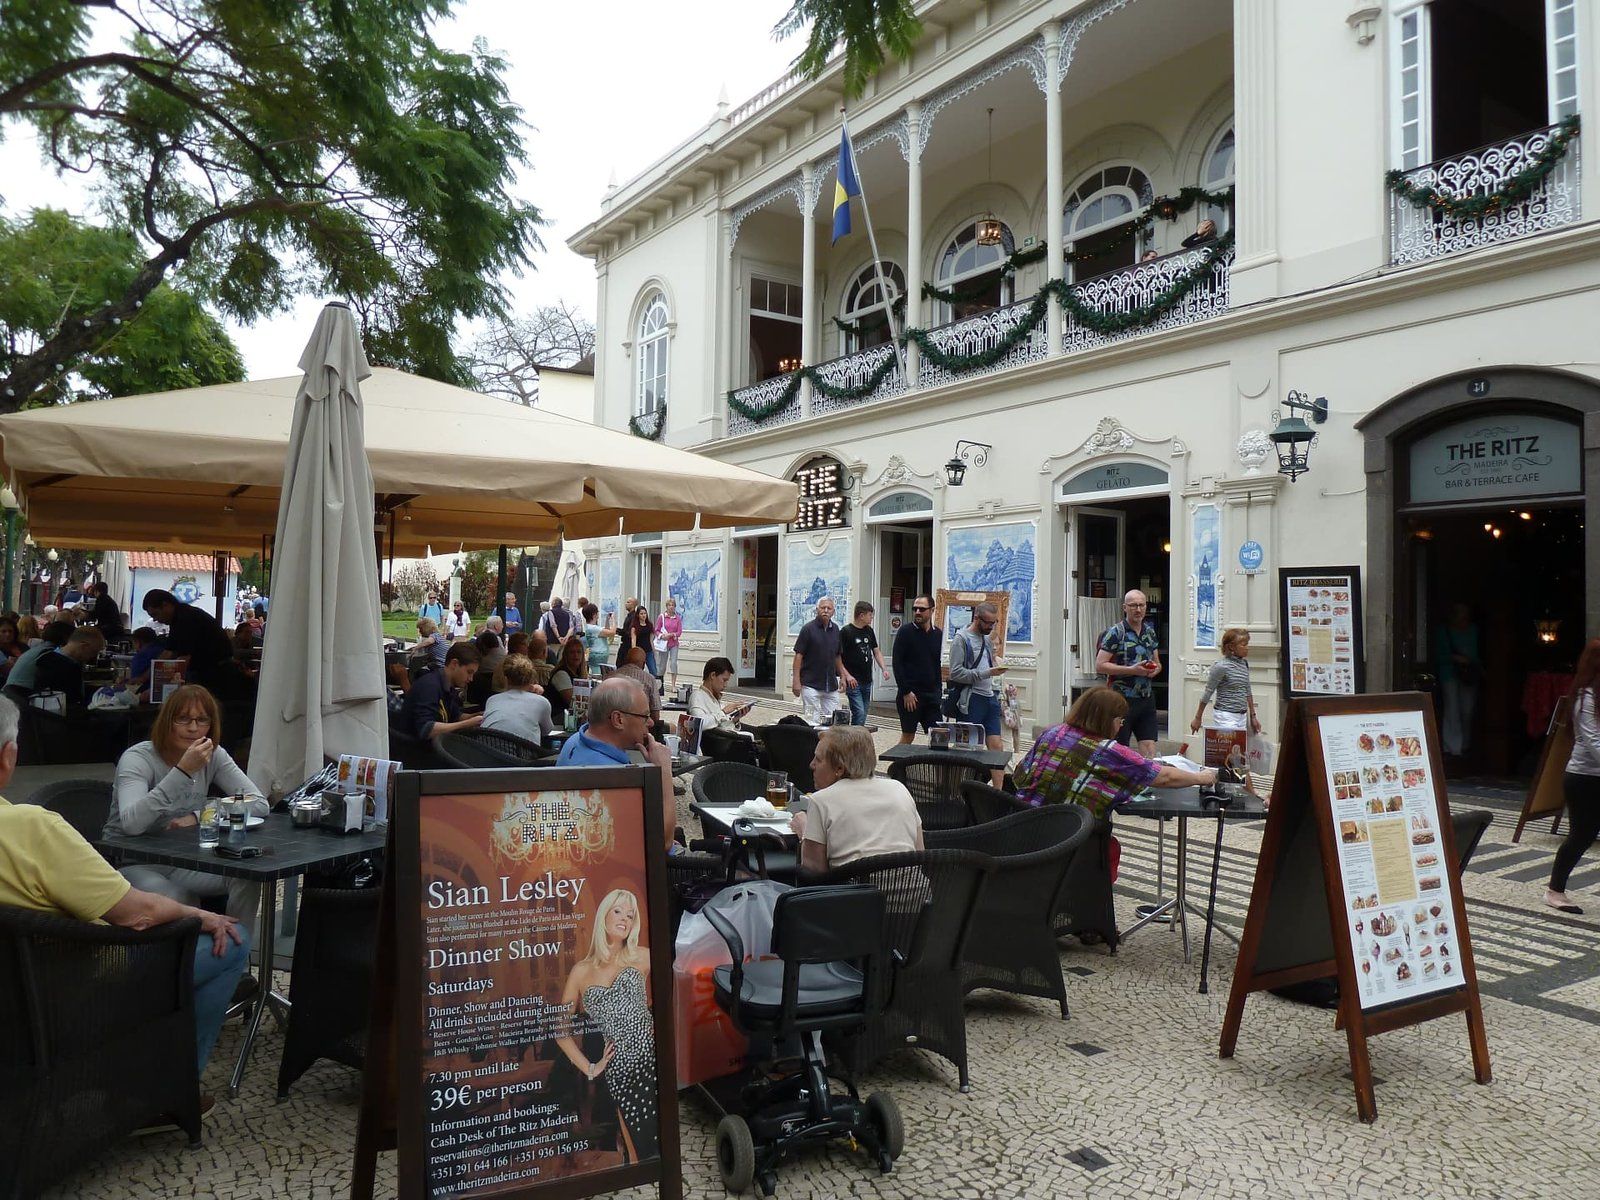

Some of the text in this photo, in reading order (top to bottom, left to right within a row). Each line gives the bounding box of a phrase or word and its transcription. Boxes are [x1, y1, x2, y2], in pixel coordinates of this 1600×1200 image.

[1446, 436, 1539, 461] THE RITZ
[1473, 459, 1509, 469] MADEIRA
[797, 465, 837, 496] THE
[1096, 477, 1131, 489] GELATO
[1445, 480, 1463, 489] BAR
[1464, 479, 1471, 488] &
[1473, 475, 1512, 487] TERRACE
[526, 801, 571, 822] THE
[522, 822, 580, 844] RITZ
[428, 871, 587, 909] Sian Lesley
[429, 938, 562, 969] Dinner Show
[428, 977, 494, 996] Saturdays
[429, 994, 544, 1018] Dinner, Show and Dancing
[429, 1018, 443, 1030] All
[444, 1015, 473, 1028] drinks
[475, 1011, 512, 1024] included
[513, 1005, 543, 1020] during
[429, 1060, 519, 1084] 7.30 pm until late
[430, 1079, 543, 1111] 39€ per person
[430, 1102, 560, 1132] Information and bookings:
[430, 1113, 579, 1149] Cash Desk of The Ritz Madeira
[430, 1130, 569, 1164] reservations@theritzmadeira.com
[431, 1167, 453, 1180] +351
[454, 1163, 472, 1175] 291
[474, 1159, 491, 1172] 644
[493, 1156, 508, 1168] 166
[514, 1150, 535, 1163] +351
[538, 1146, 555, 1158] 936
[556, 1143, 572, 1155] 156
[573, 1139, 589, 1152] 935
[432, 1165, 540, 1197] www.theritzmadeira.com
